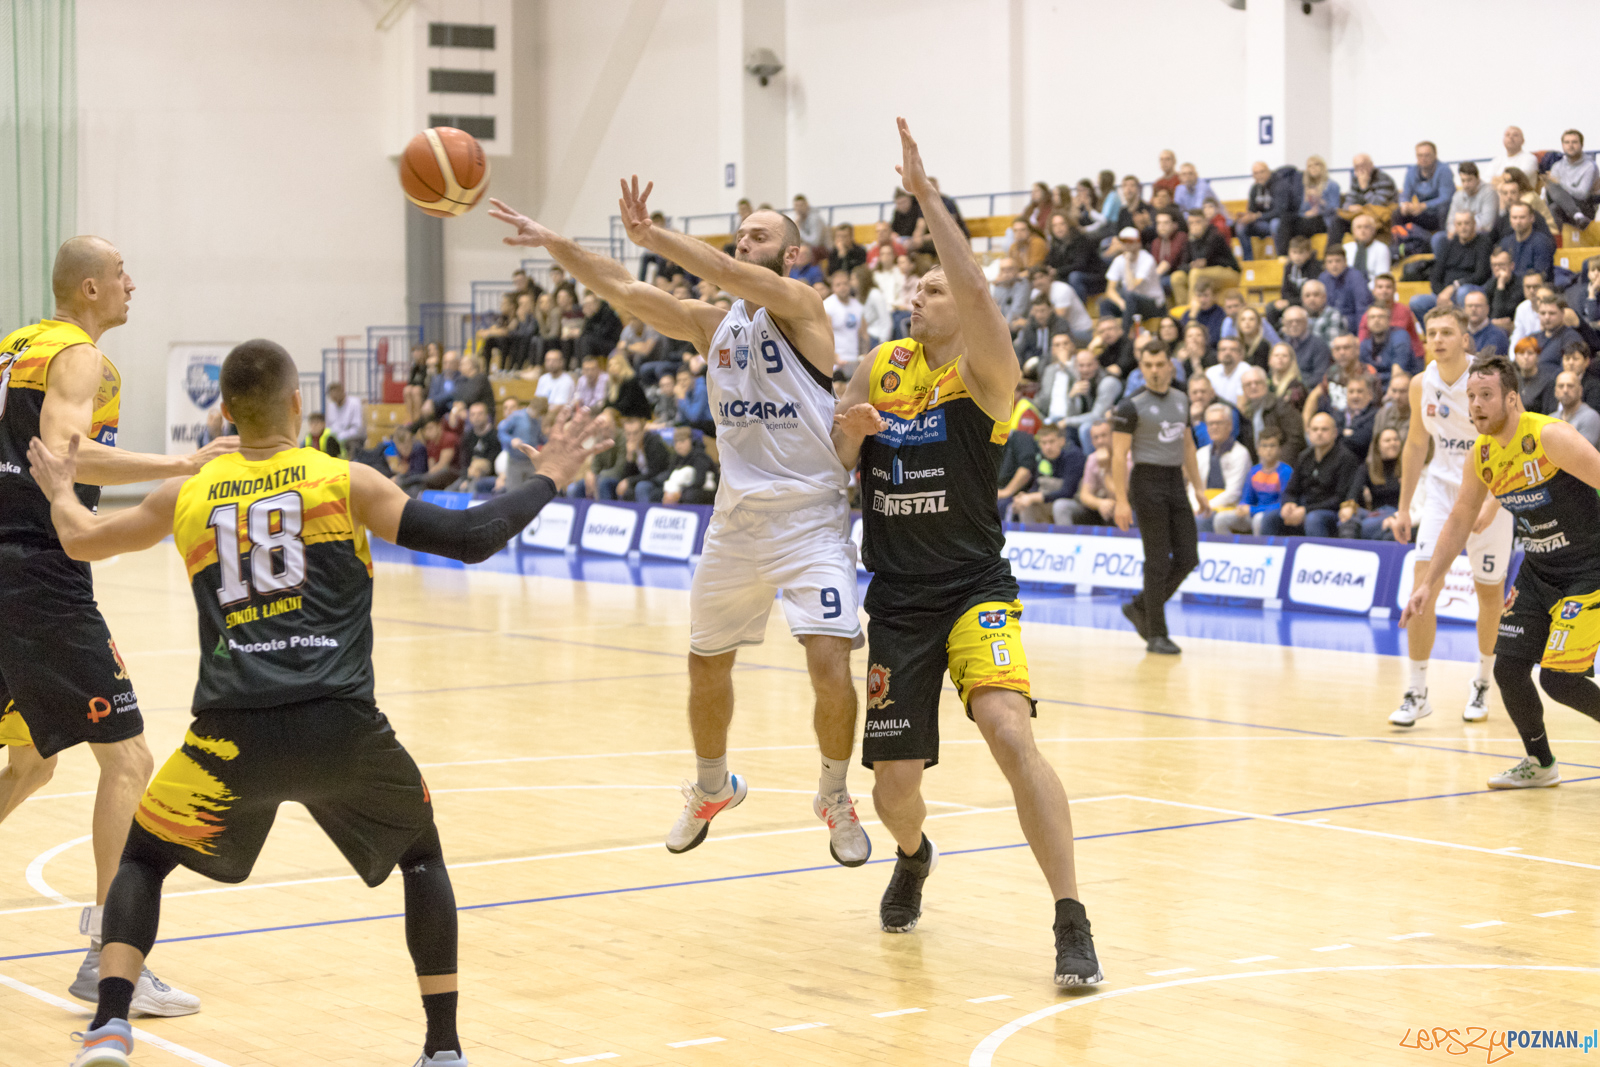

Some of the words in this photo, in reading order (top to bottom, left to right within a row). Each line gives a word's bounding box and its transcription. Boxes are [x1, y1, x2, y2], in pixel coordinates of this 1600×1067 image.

[761, 330, 769, 340] C
[761, 340, 784, 374] 9
[765, 420, 799, 432] acjentów
[904, 467, 945, 480] TOWERS
[1523, 457, 1545, 486] 91
[206, 490, 307, 608] 18
[1482, 554, 1495, 573] 5
[1296, 569, 1367, 588] BIOFARM
[820, 587, 842, 619] 9
[290, 633, 338, 648] Polska
[1548, 630, 1569, 651] 91
[991, 639, 1011, 666] 6
